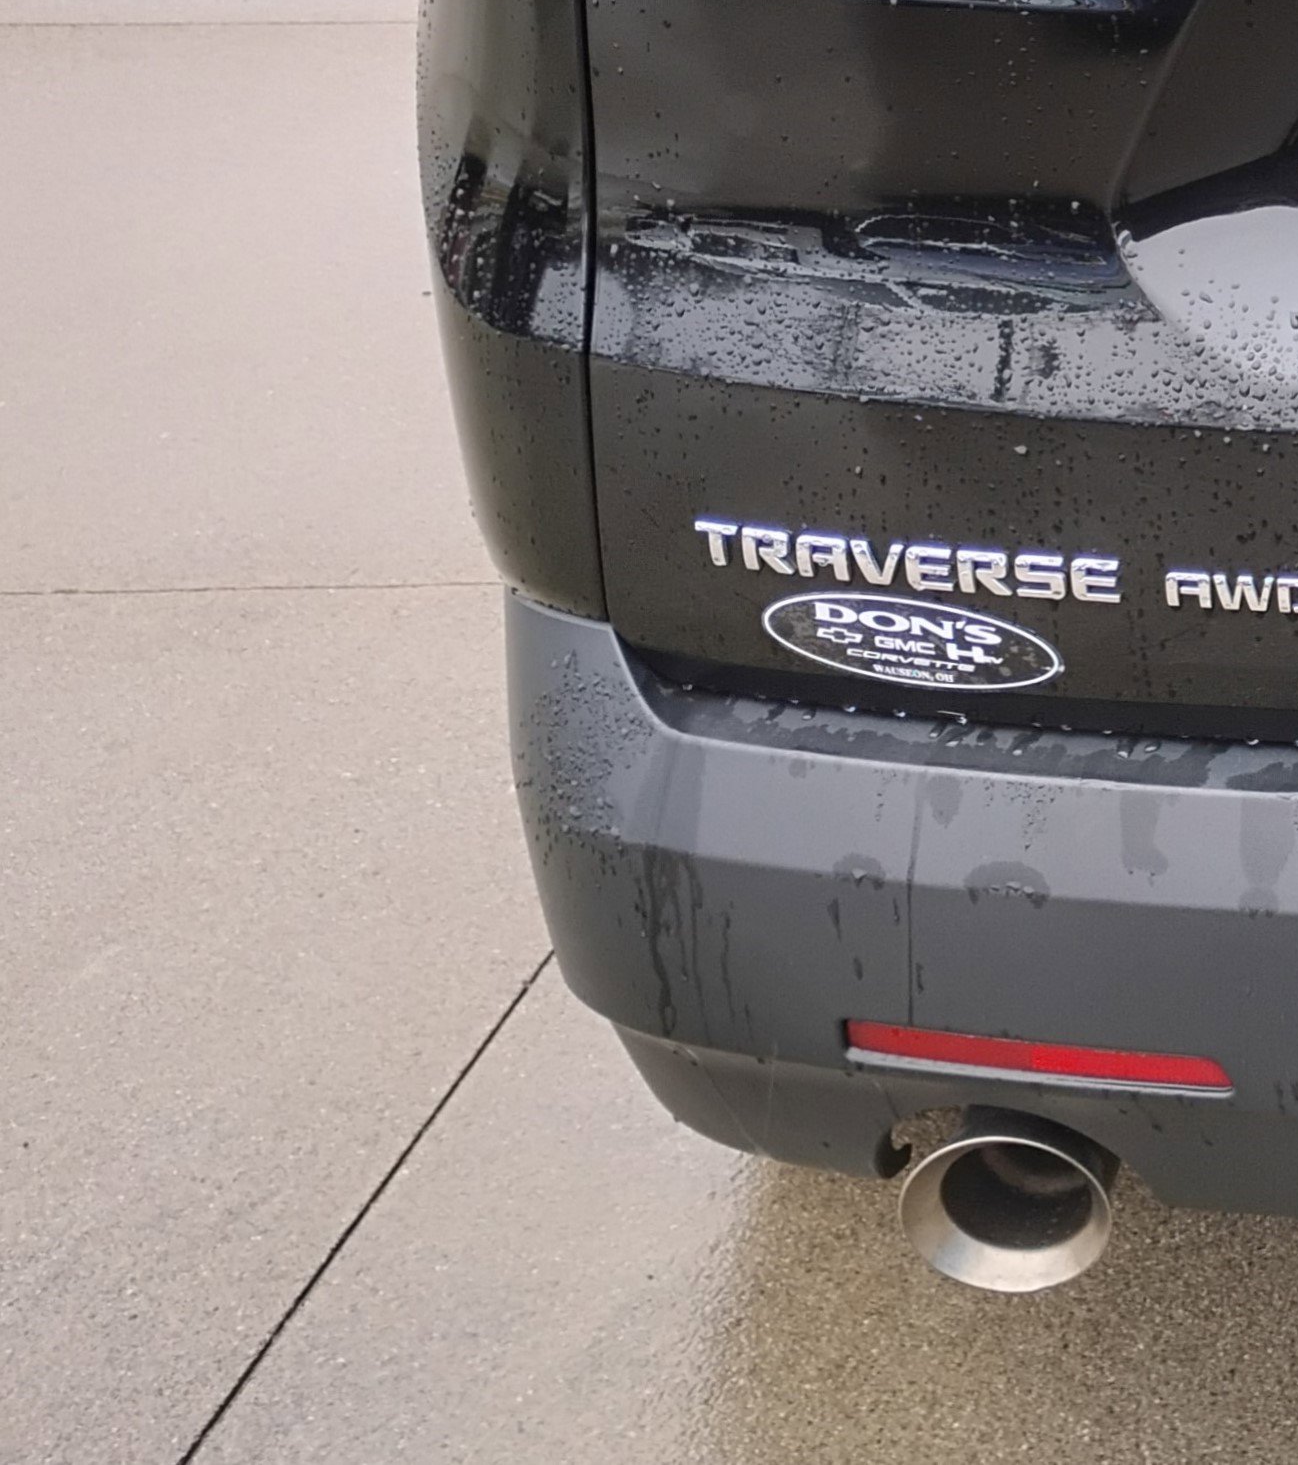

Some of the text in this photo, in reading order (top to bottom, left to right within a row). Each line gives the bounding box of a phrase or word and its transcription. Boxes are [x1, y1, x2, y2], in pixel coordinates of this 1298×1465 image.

[693, 518, 1122, 605] TRAVERSE
[813, 601, 1003, 646] DON'S
[873, 635, 936, 656] GMC
[846, 647, 977, 673] CORVETTE
[872, 663, 955, 684] WAUSEON, OH
